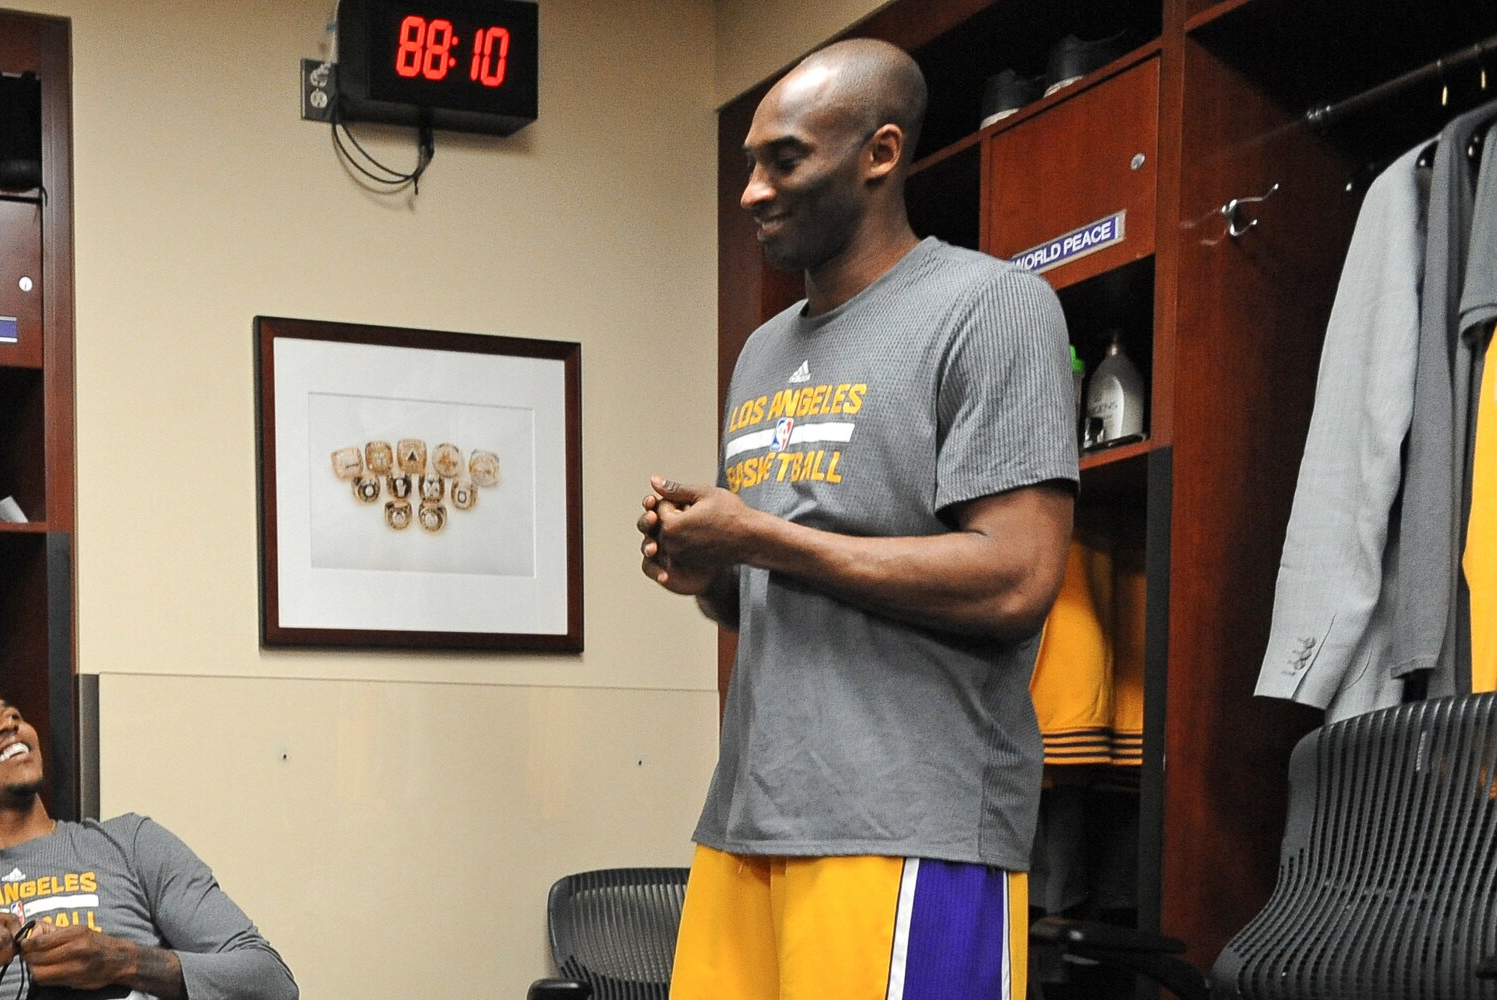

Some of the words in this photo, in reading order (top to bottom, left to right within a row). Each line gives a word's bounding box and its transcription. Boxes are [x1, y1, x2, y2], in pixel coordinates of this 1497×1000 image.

[1012, 242, 1061, 270] WORLD
[1063, 221, 1112, 255] PEACE
[729, 396, 767, 433] LOS
[767, 383, 868, 421] ANGELES
